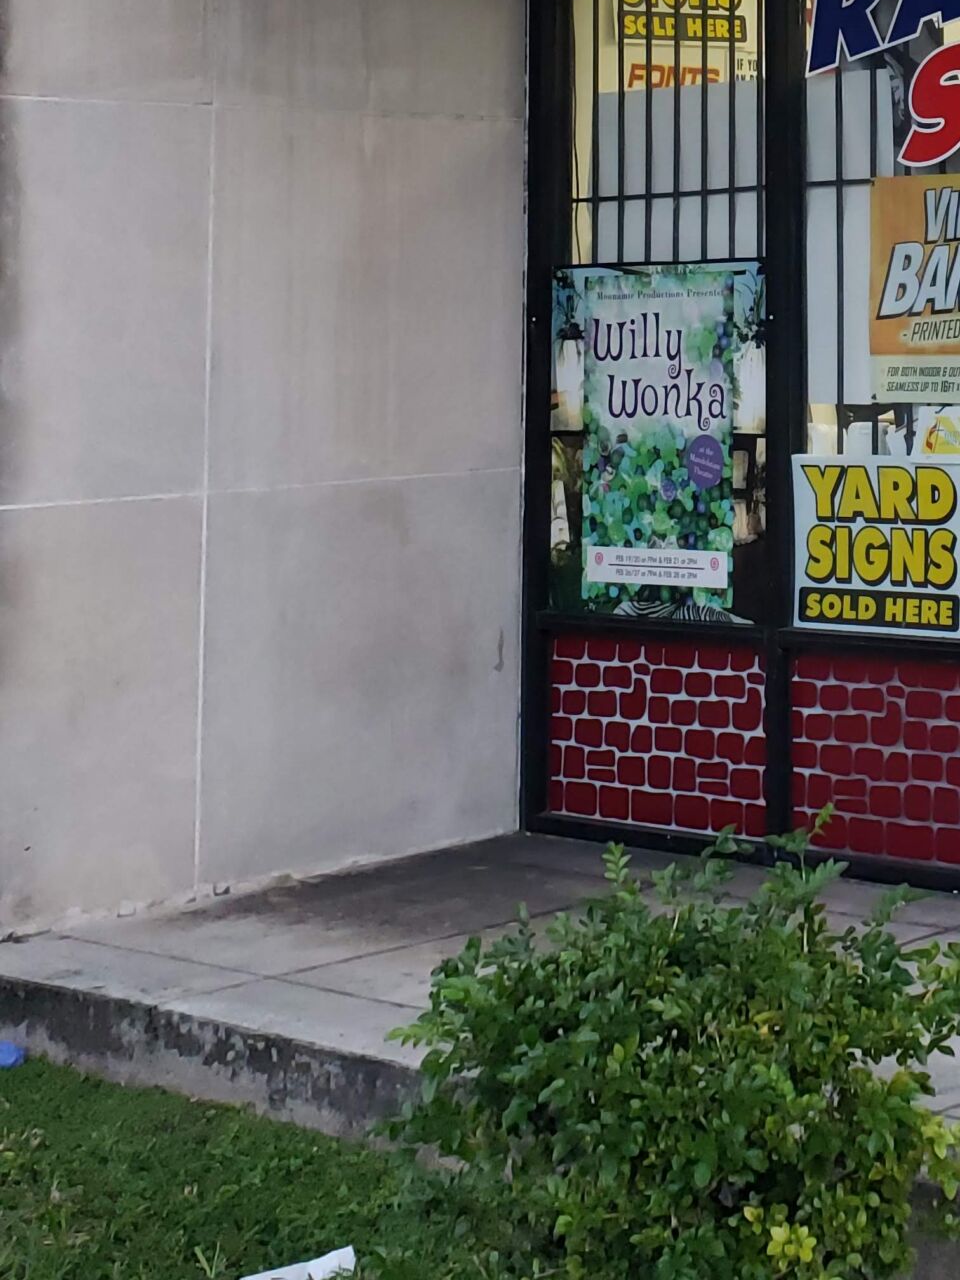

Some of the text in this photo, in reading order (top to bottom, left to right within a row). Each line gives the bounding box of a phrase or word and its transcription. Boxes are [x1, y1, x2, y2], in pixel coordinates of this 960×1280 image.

[624, 16, 742, 38] SOLD HERE
[637, 290, 683, 300] Productions
[592, 313, 682, 379] Willy
[886, 382, 920, 392] SEAMLESS
[920, 382, 930, 392] UP
[931, 382, 939, 392] TO
[887, 367, 900, 377] FOR
[901, 367, 918, 377] BOTH
[607, 368, 727, 431] Wonka
[801, 464, 957, 522] YARD
[806, 525, 958, 588] SIGNS
[805, 593, 877, 620] SOLD
[884, 597, 954, 627] HERE
